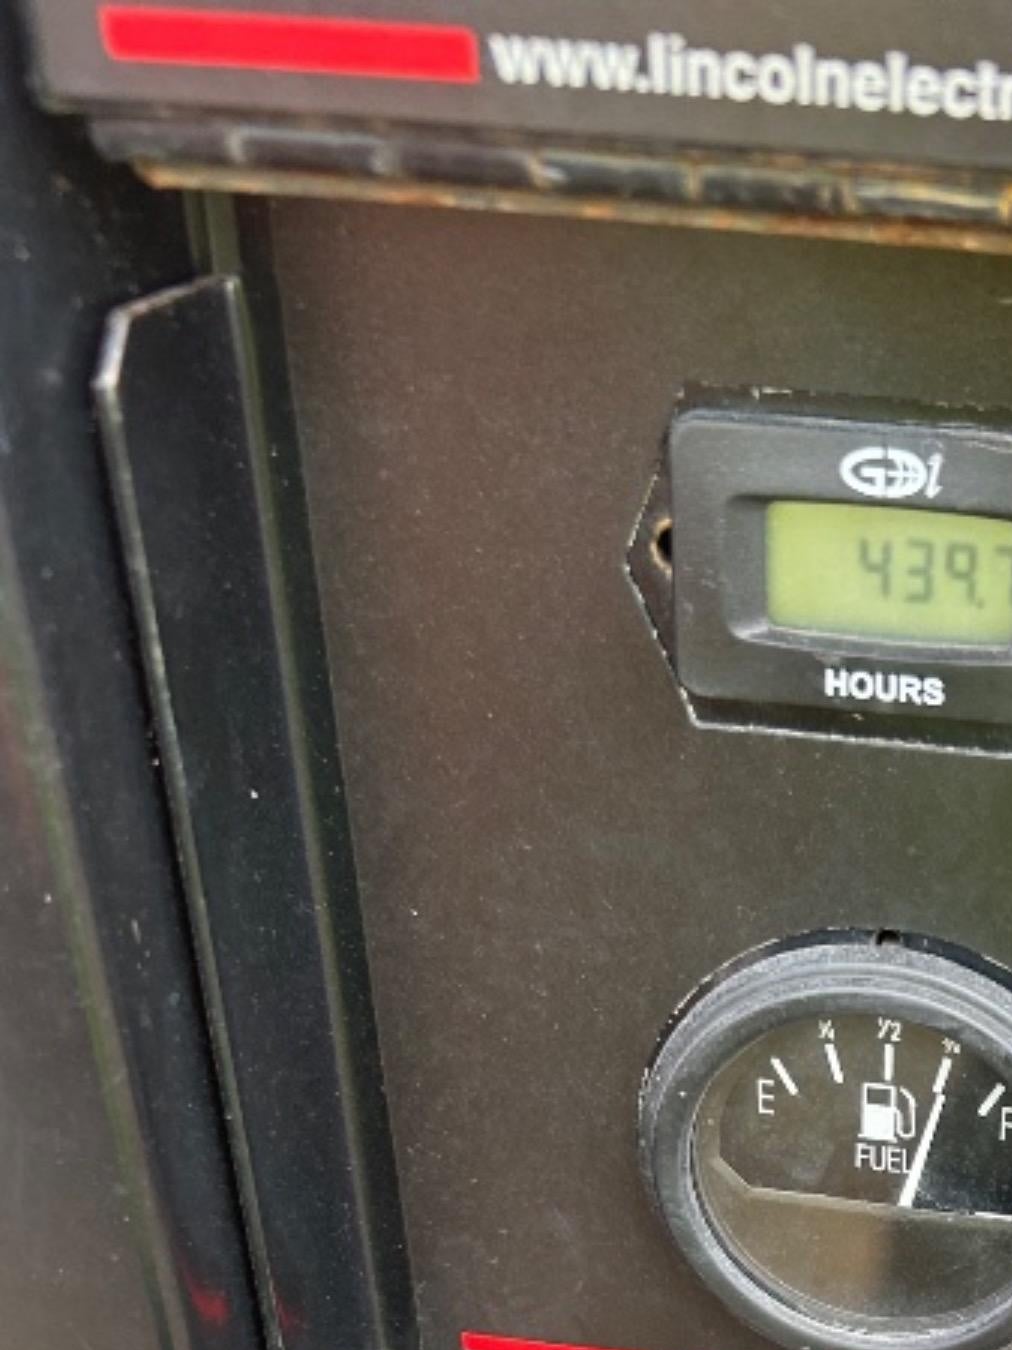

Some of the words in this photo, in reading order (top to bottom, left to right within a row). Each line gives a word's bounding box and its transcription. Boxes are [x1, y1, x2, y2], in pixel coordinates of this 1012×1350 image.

[824, 668, 946, 706] HOURS
[757, 1078, 775, 1115] E
[855, 1143, 911, 1173] FUEL
